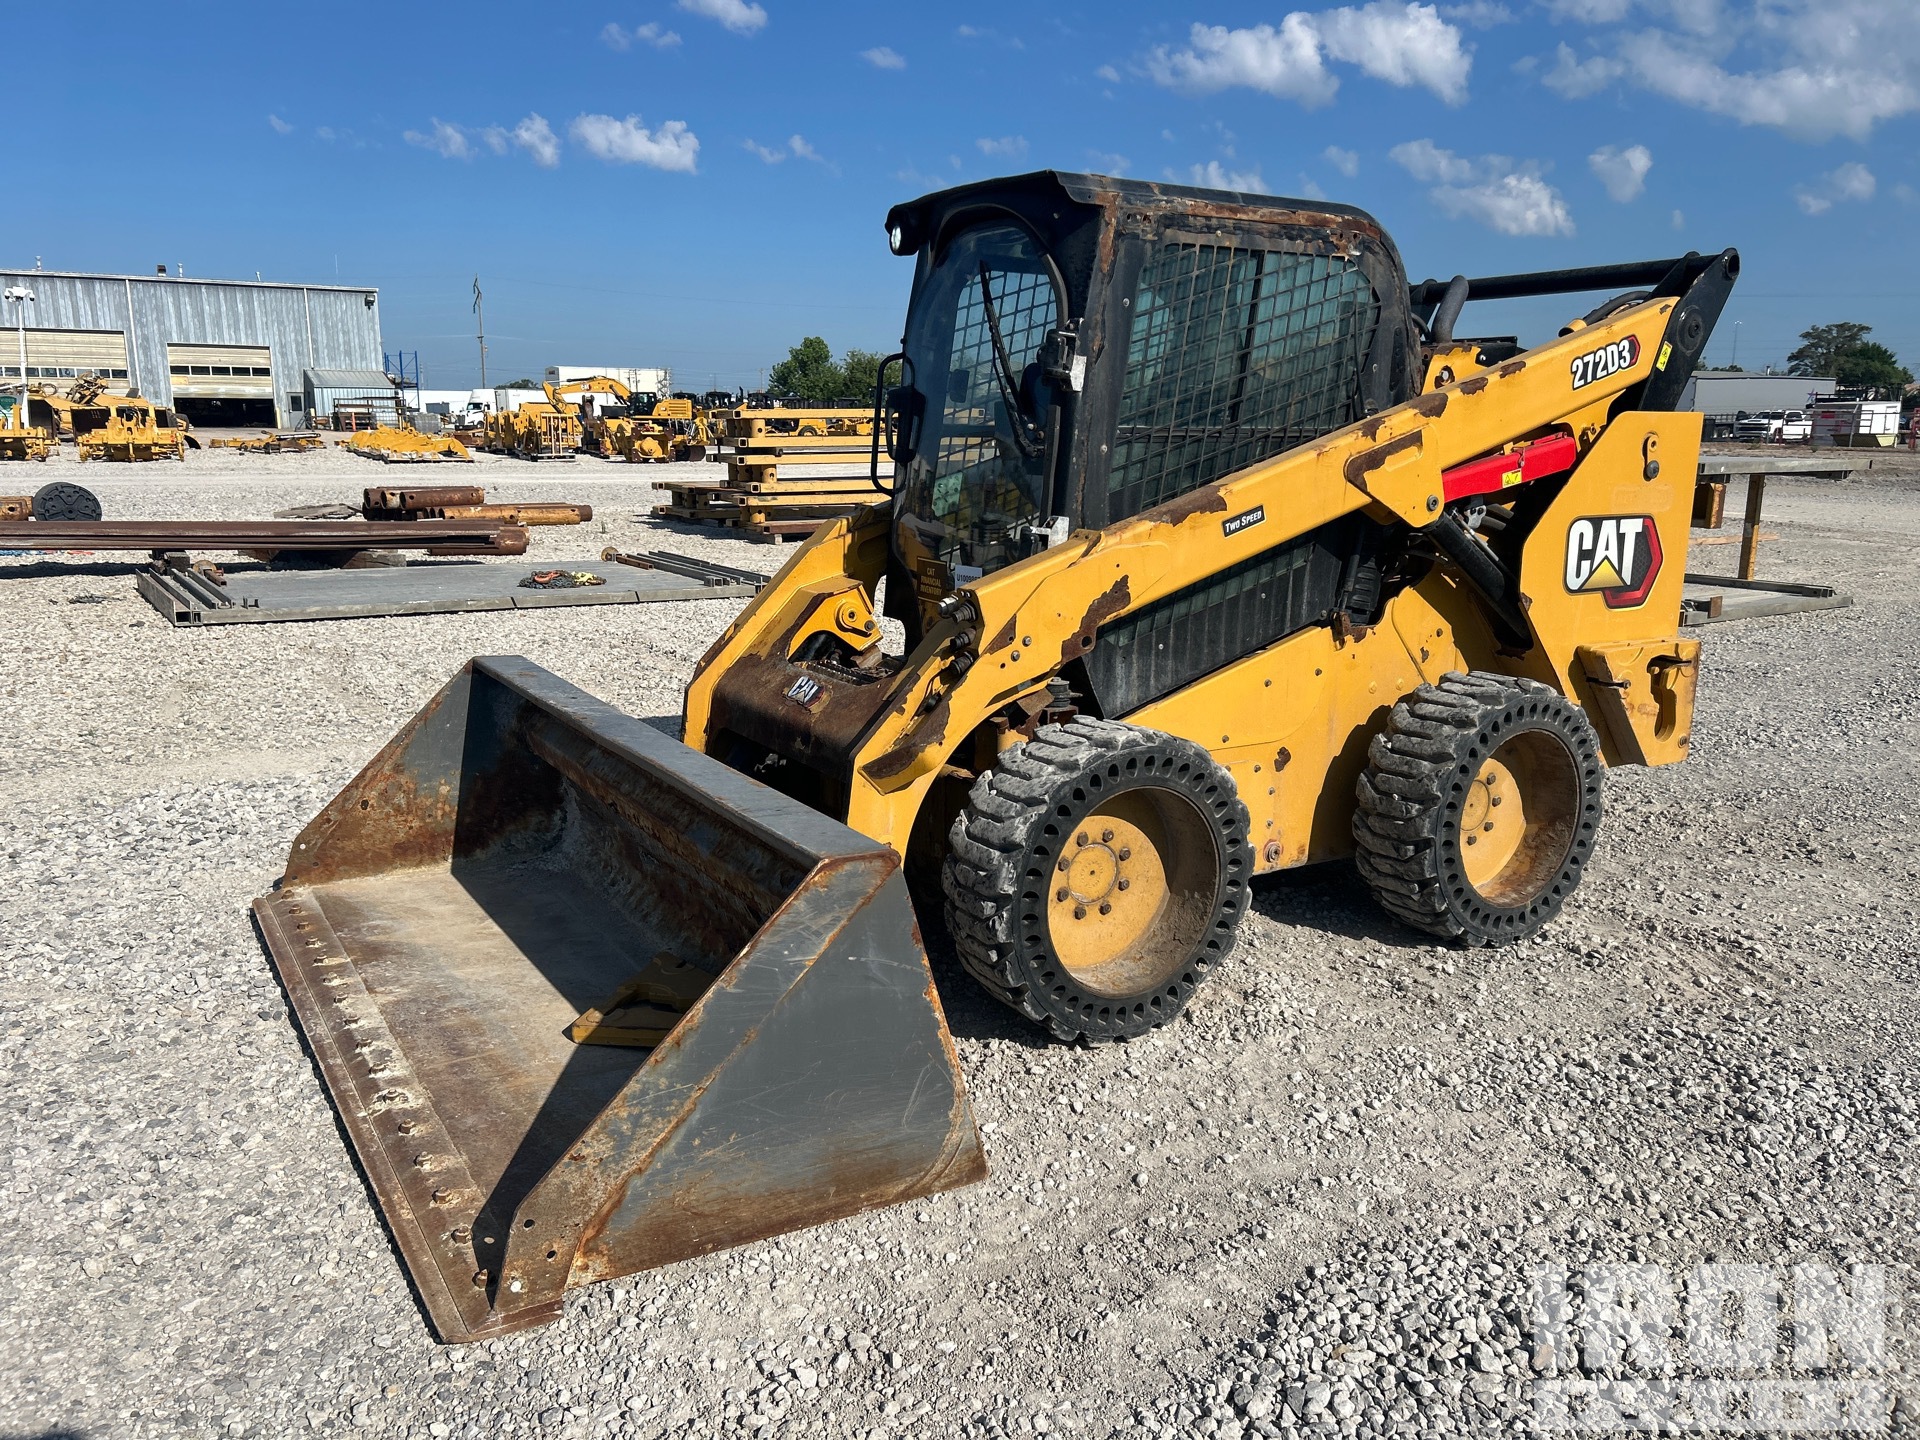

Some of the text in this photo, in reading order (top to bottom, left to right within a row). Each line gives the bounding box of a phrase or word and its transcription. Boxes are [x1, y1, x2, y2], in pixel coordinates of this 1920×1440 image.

[1571, 339, 1631, 389] 272D3
[926, 568, 935, 576] CAT
[1566, 518, 1643, 590] CAT
